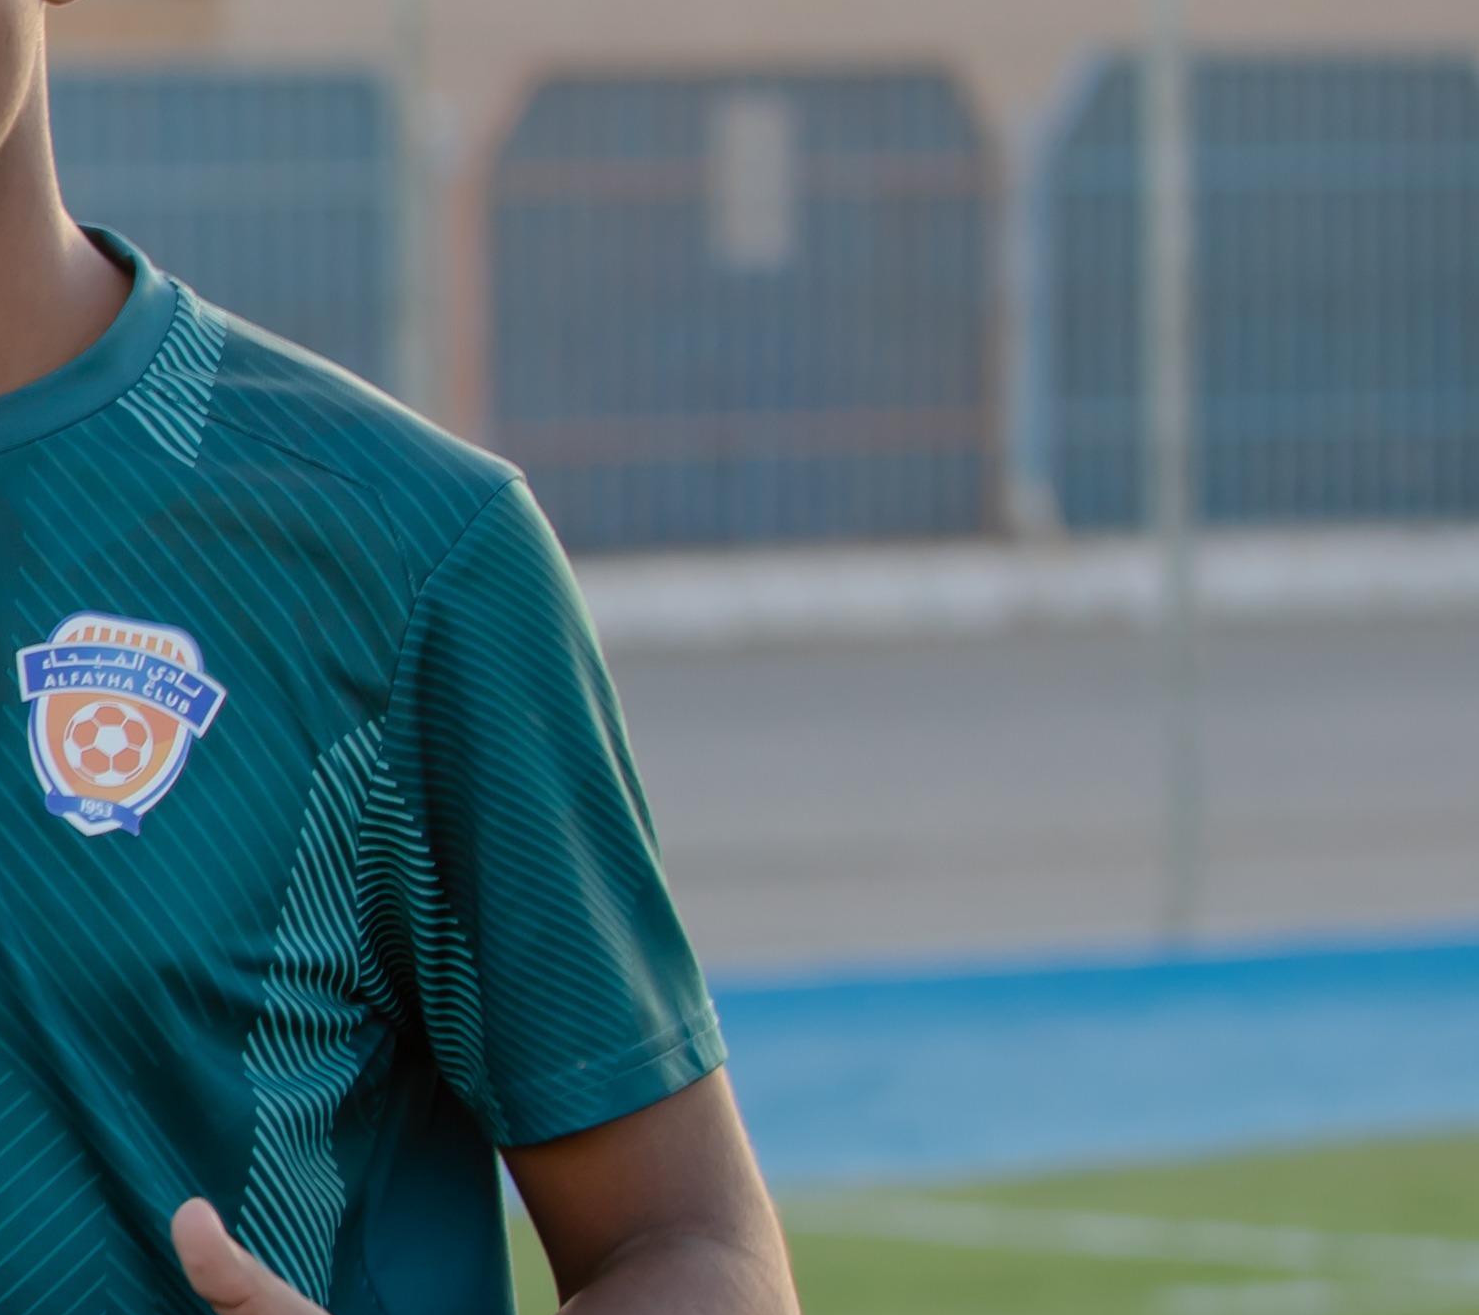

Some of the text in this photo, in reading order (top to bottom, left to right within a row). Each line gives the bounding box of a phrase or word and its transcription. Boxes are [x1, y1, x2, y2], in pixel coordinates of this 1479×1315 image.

[44, 671, 191, 715] ALFAYHA CLUB
[80, 798, 114, 819] 1953
